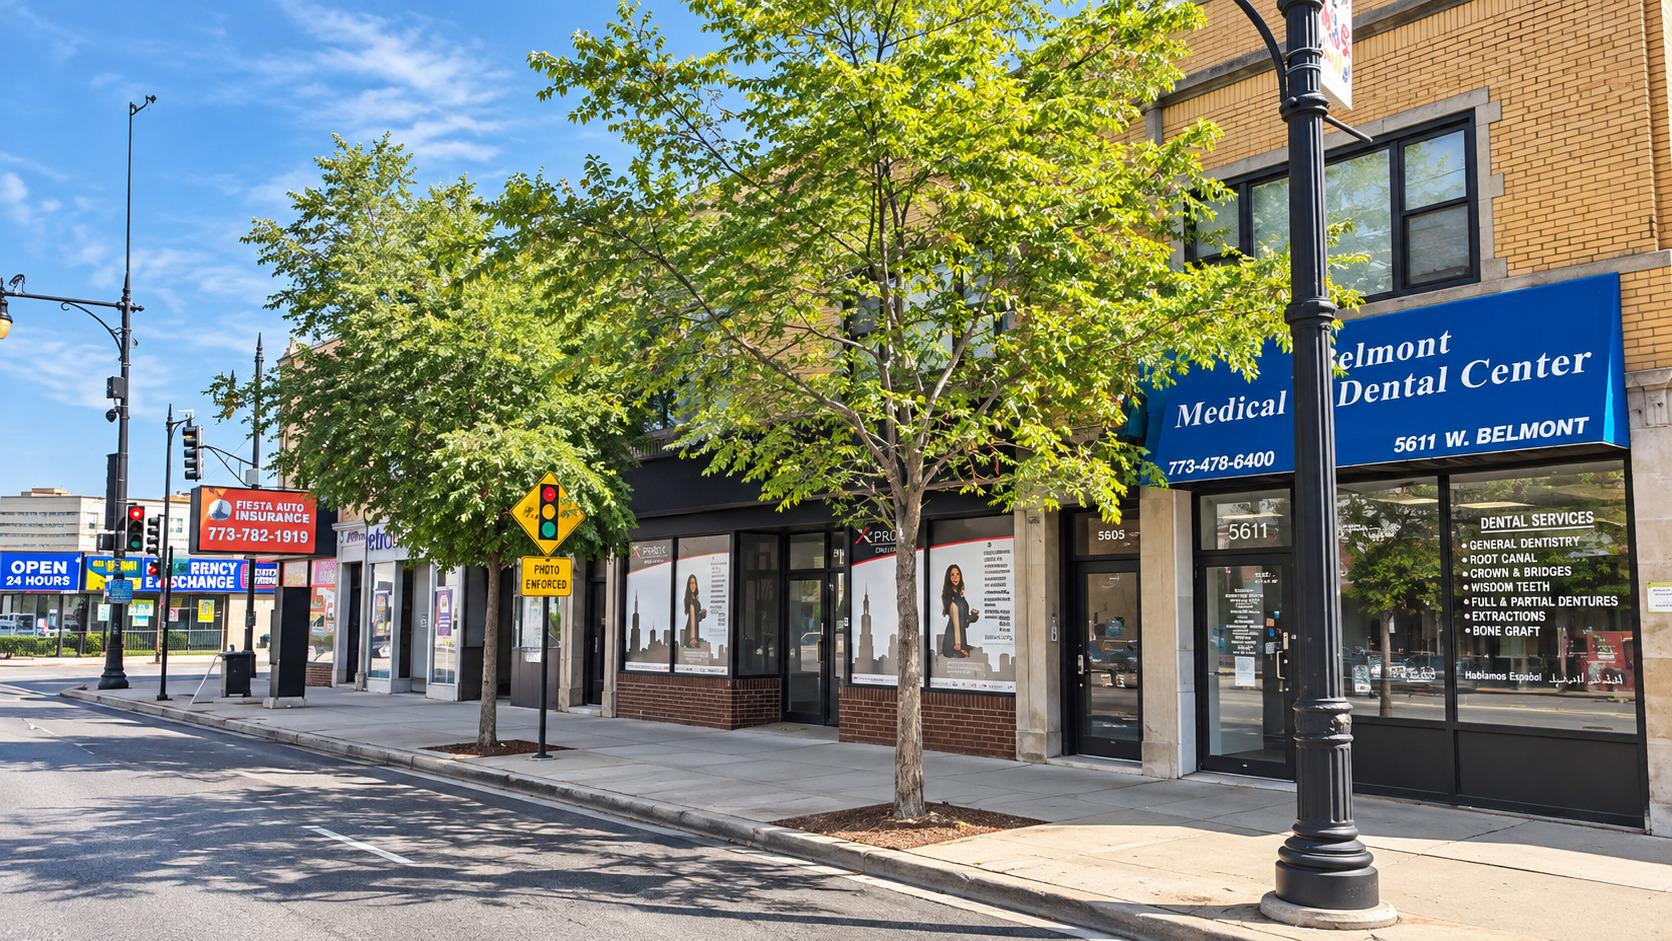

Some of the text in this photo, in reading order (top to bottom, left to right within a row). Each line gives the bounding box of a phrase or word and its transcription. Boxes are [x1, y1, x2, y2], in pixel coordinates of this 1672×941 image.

[1174, 348, 1592, 429] Medical Dental Center
[1393, 417, 1589, 453] 5611 W. BELMONT
[1168, 451, 1275, 475] 773-478-6400
[236, 500, 304, 512] FIESTA AUTO
[235, 511, 310, 523] INSURANCE
[1481, 511, 1594, 529] DENTAL SERVICES
[208, 527, 308, 544] 773-782-1919
[1098, 530, 1125, 541] 5605
[1228, 523, 1268, 540] 5611
[1470, 536, 1580, 550] GENERAL DENTISTRY
[1470, 553, 1537, 564] ROOT CANAL
[11, 561, 67, 574] OPEN
[534, 564, 560, 575] PHOTO
[1470, 566, 1572, 578] CROWN & BRIDGES
[6, 576, 70, 586] 24 HOURS
[526, 579, 567, 590] ENFORCED
[1471, 581, 1550, 592] WISDOM TEETH
[1472, 595, 1618, 607] FULL & PARTIAL DENTURES
[1472, 611, 1546, 622] EXTRACTIONS
[1473, 626, 1540, 637] BONE GRAFT
[1465, 670, 1506, 681] Hablamos
